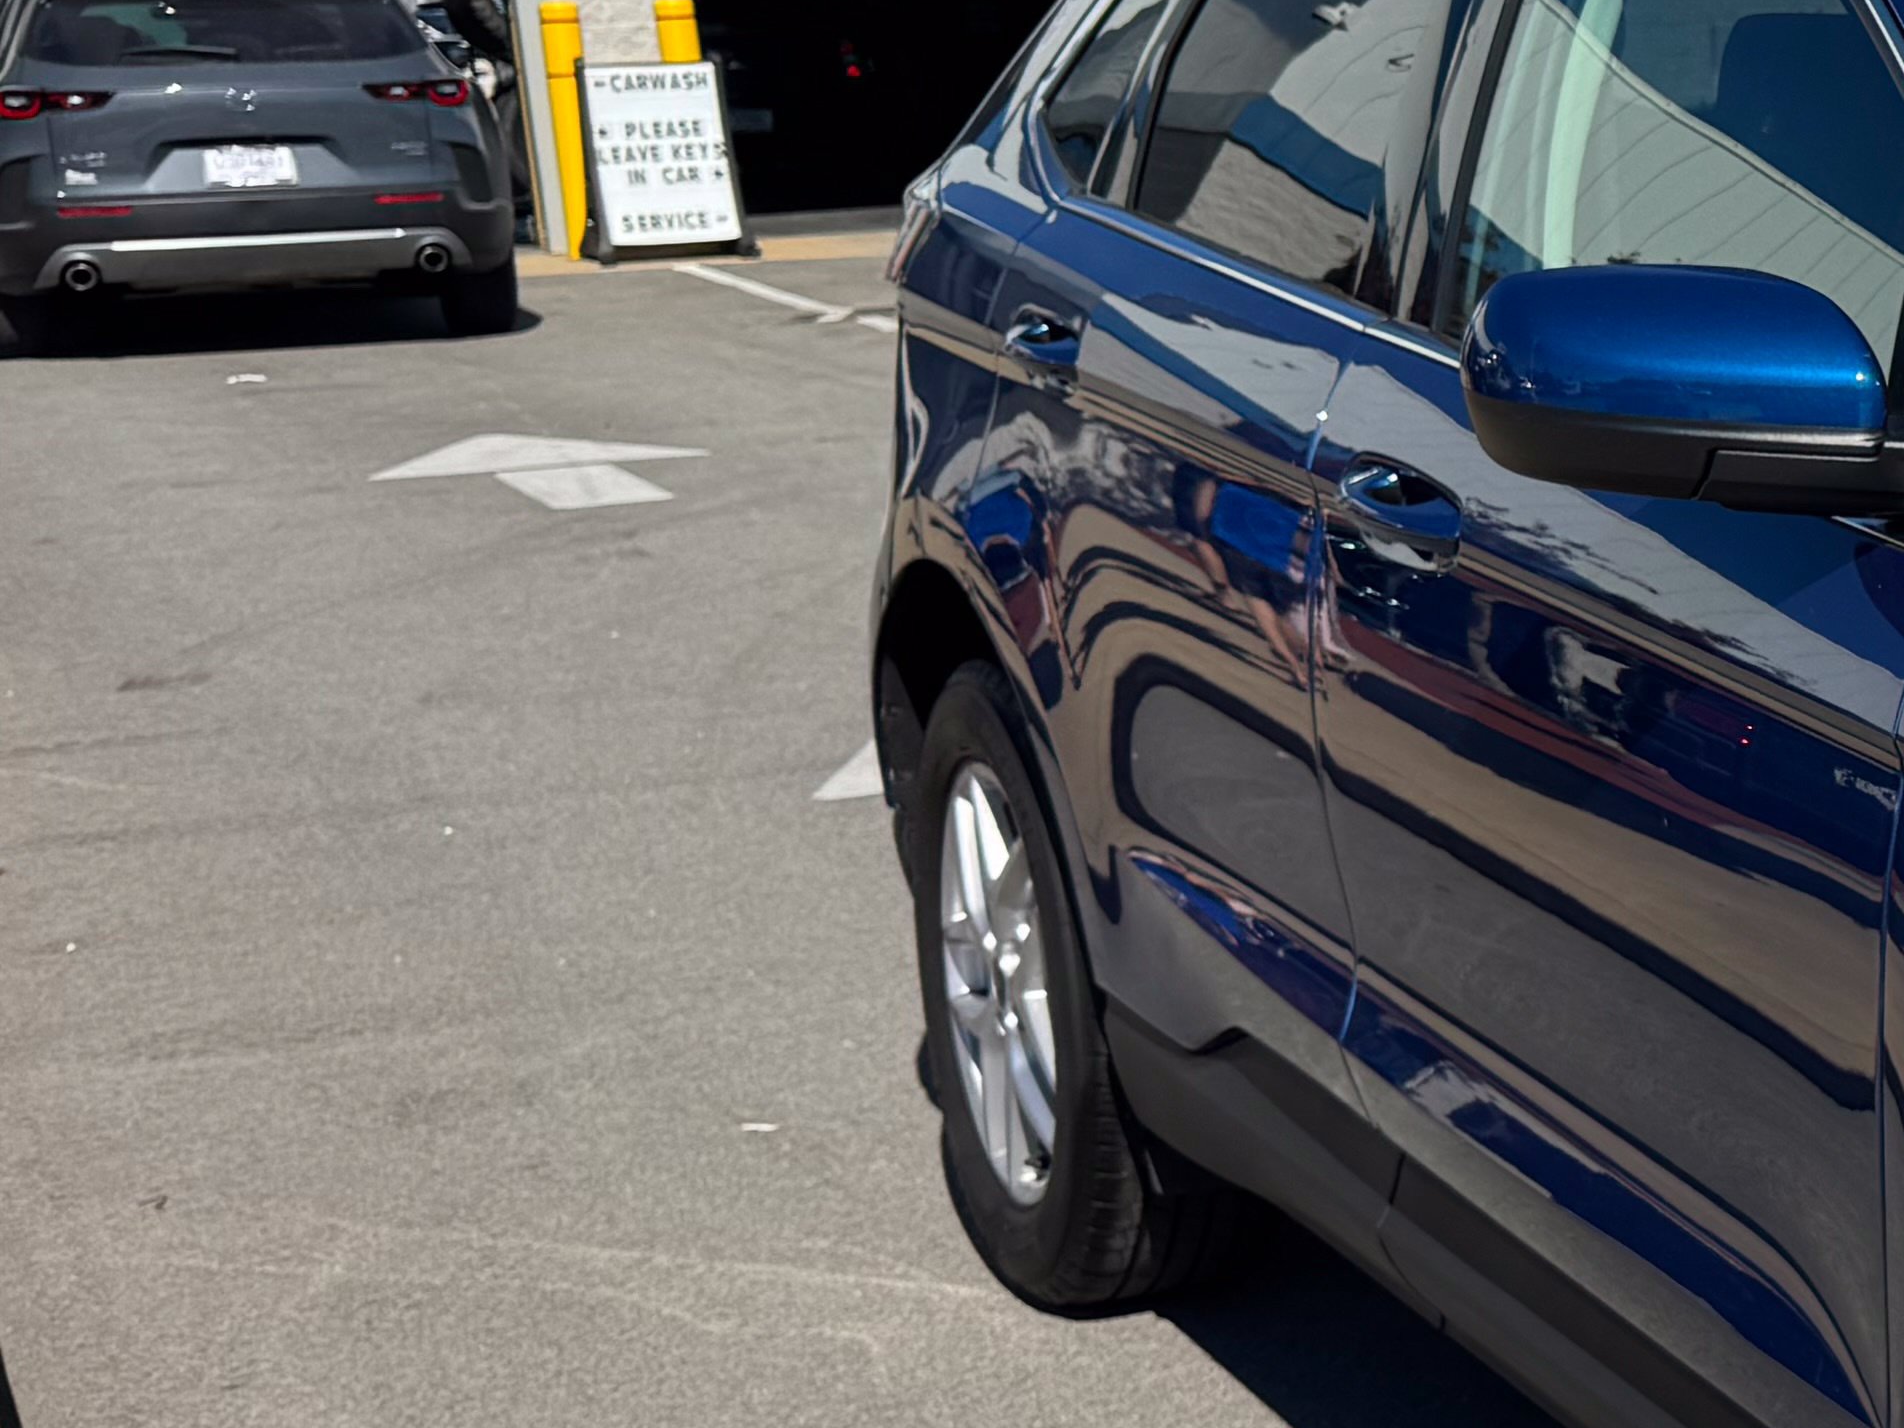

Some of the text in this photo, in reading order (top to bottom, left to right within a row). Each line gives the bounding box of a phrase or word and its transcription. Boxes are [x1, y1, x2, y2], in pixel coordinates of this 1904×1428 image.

[610, 72, 708, 93] CARWASH
[625, 120, 702, 139] PLEASE
[598, 141, 727, 165] LEAVE KEYS
[628, 166, 702, 185] IN CAR
[622, 212, 709, 233] SERVICE
